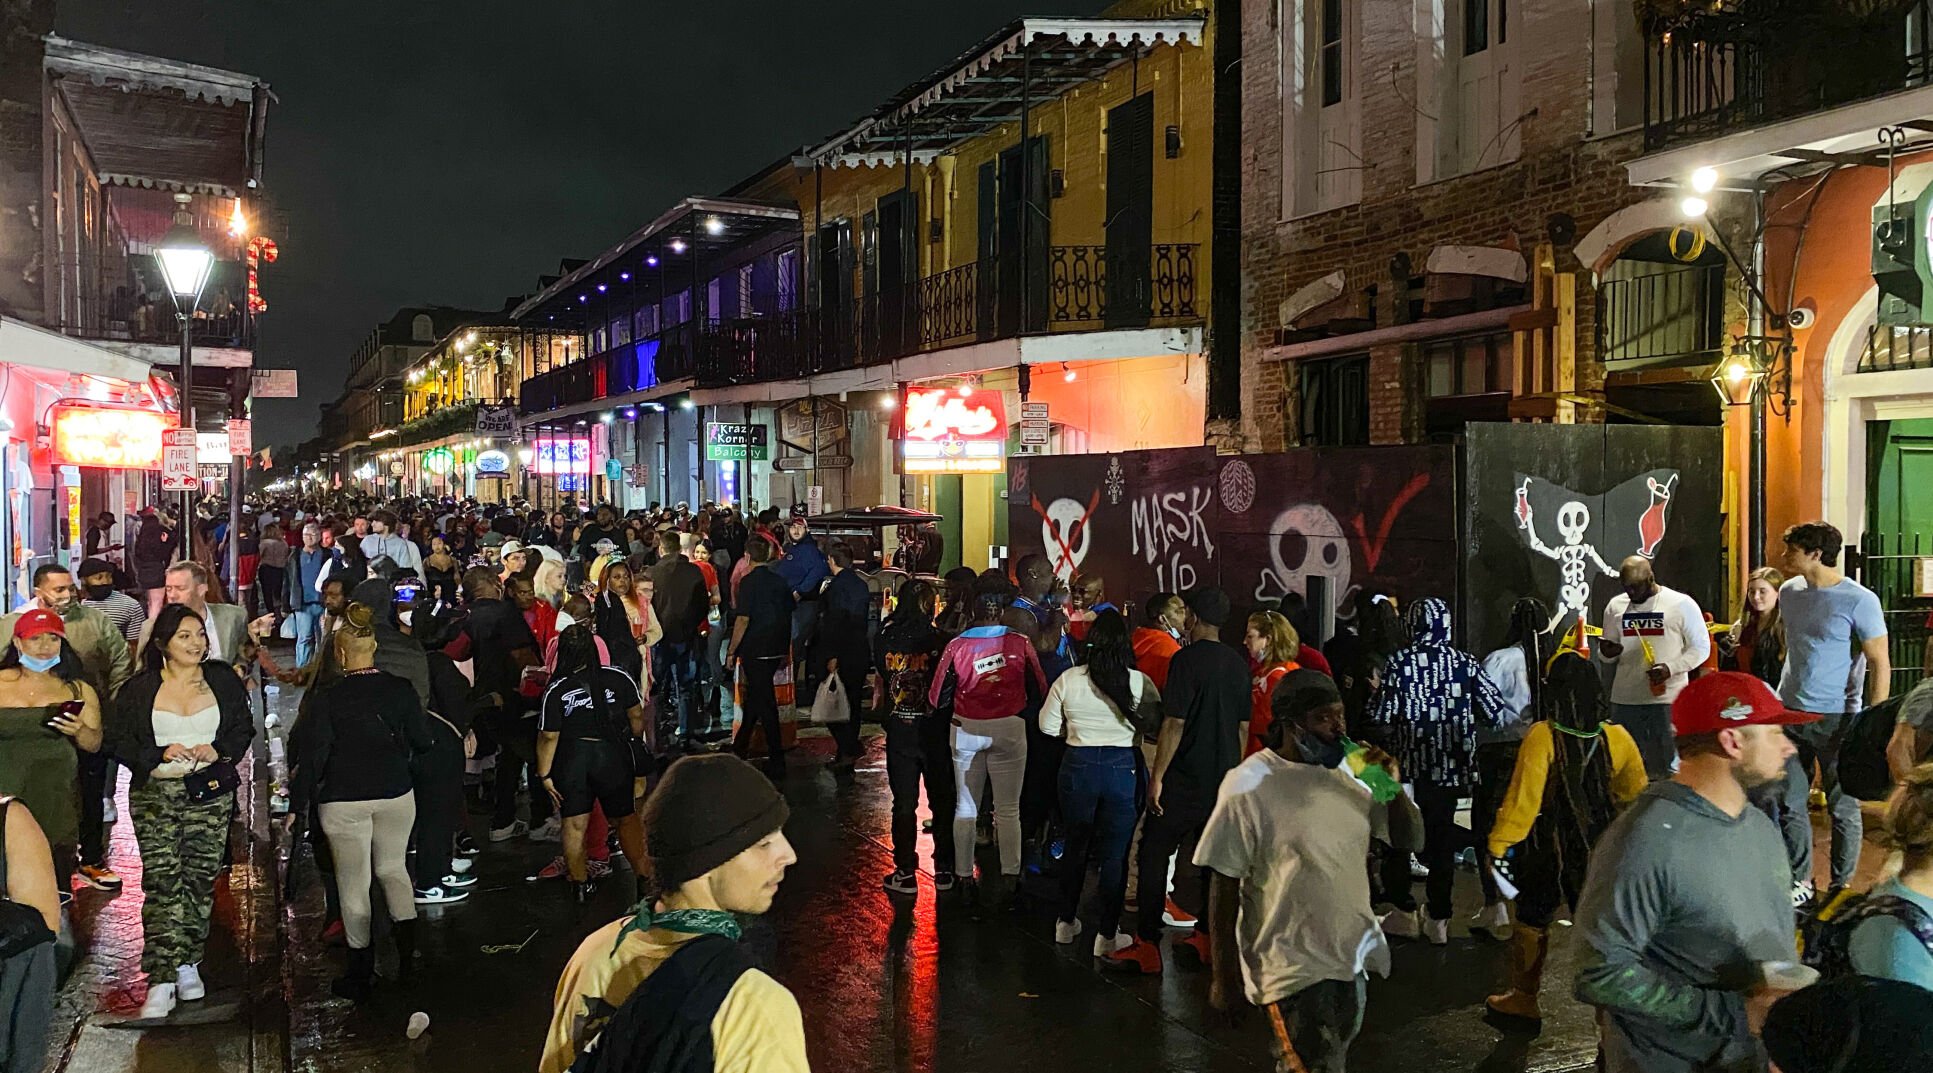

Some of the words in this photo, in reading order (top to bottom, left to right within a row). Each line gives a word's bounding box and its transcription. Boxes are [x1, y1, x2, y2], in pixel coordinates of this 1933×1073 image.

[163, 432, 174, 444] NO
[717, 433, 758, 444] Kornr
[170, 450, 188, 459] FIRE
[170, 463, 191, 473] LANE
[1131, 486, 1215, 565] MASK
[1156, 551, 1197, 594] UP
